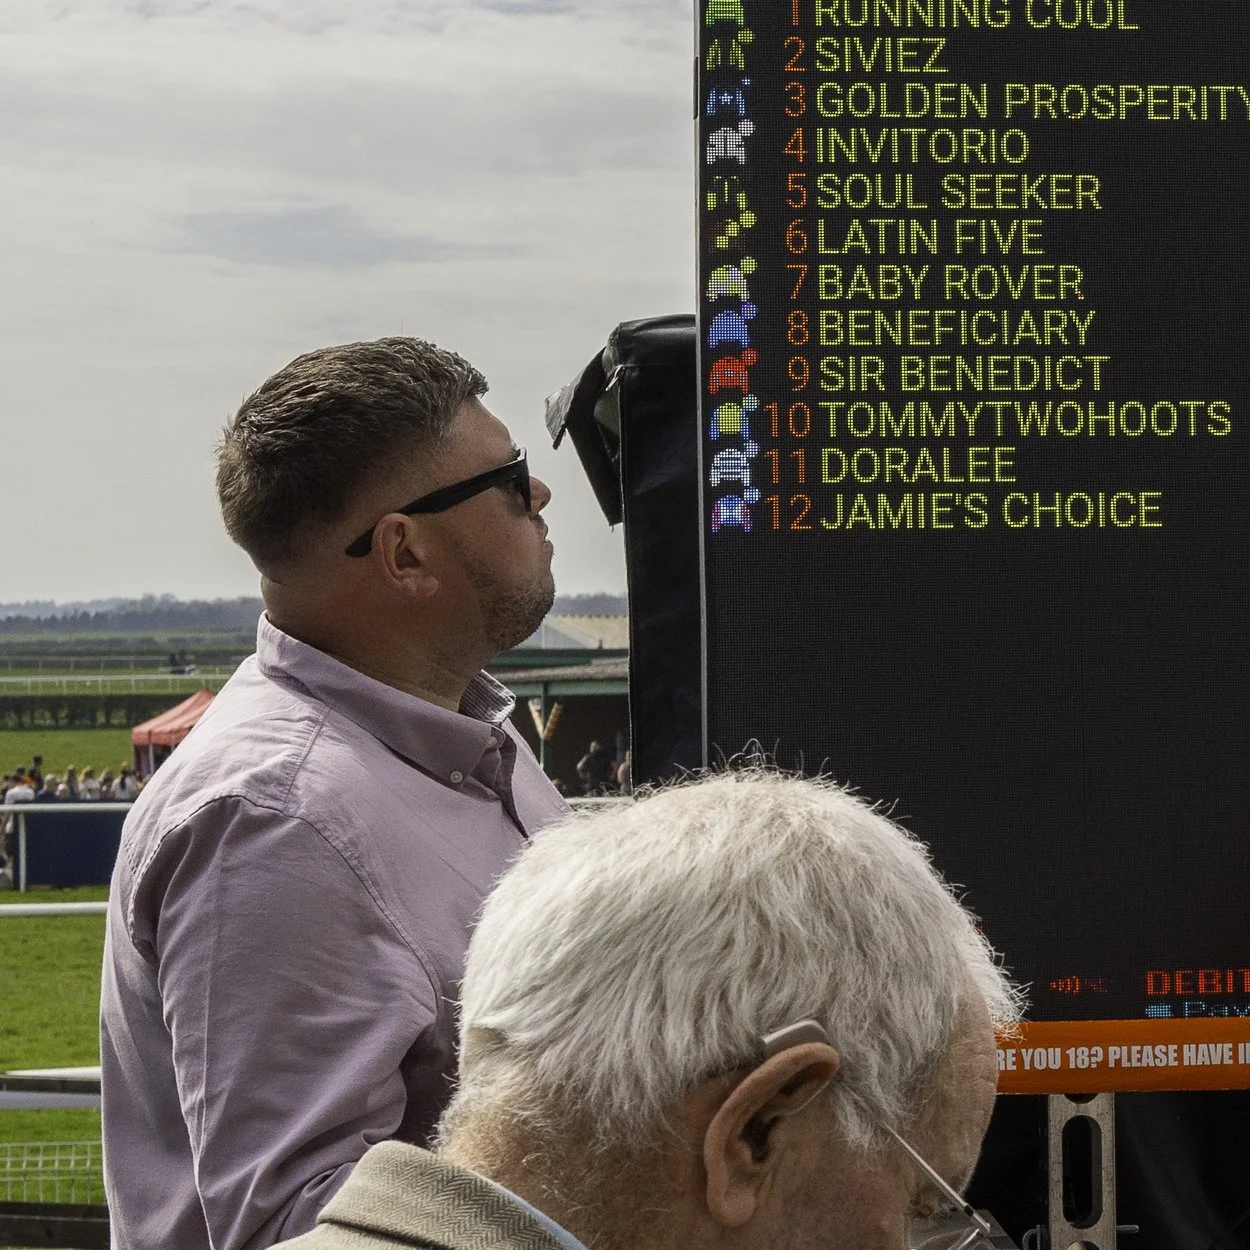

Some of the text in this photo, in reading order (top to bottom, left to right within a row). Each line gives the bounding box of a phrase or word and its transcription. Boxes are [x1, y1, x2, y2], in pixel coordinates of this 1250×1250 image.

[816, 0, 1010, 27] RUNNING
[1027, 0, 1138, 29] COOL
[785, 37, 807, 71] 2
[816, 37, 948, 72] SIVIEZ
[785, 82, 805, 116] 3
[817, 83, 987, 117] GOLDEN
[785, 128, 805, 162] 4
[817, 128, 1029, 163] INVITORIO
[789, 174, 806, 207] 5
[818, 174, 927, 208] SOUL
[942, 174, 1101, 209] SEEKER
[787, 219, 806, 253] 6
[819, 219, 937, 253] LATIN
[957, 220, 1042, 254] FIVE
[787, 265, 807, 299] 7
[819, 265, 928, 299] BABY
[946, 265, 1084, 299] ROVER
[788, 311, 808, 344] 8
[820, 311, 1095, 345] BENEFICIARY
[789, 357, 809, 390] 9
[821, 356, 884, 391] SIR
[902, 356, 1110, 390] BENEDICT
[764, 403, 810, 436] 10
[819, 402, 1230, 437] TOMMYTWOHOOTS
[765, 449, 804, 483] 11
[822, 447, 1015, 482] DORALEE
[765, 495, 811, 529] 12
[821, 493, 987, 529] JAMIE'S
[1005, 492, 1162, 527] CHOICE
[1021, 1047, 1061, 1070] YOU
[1066, 1046, 1104, 1069] 18?
[1108, 1044, 1178, 1068] PLEASE
[1183, 1043, 1233, 1066] HAVE
